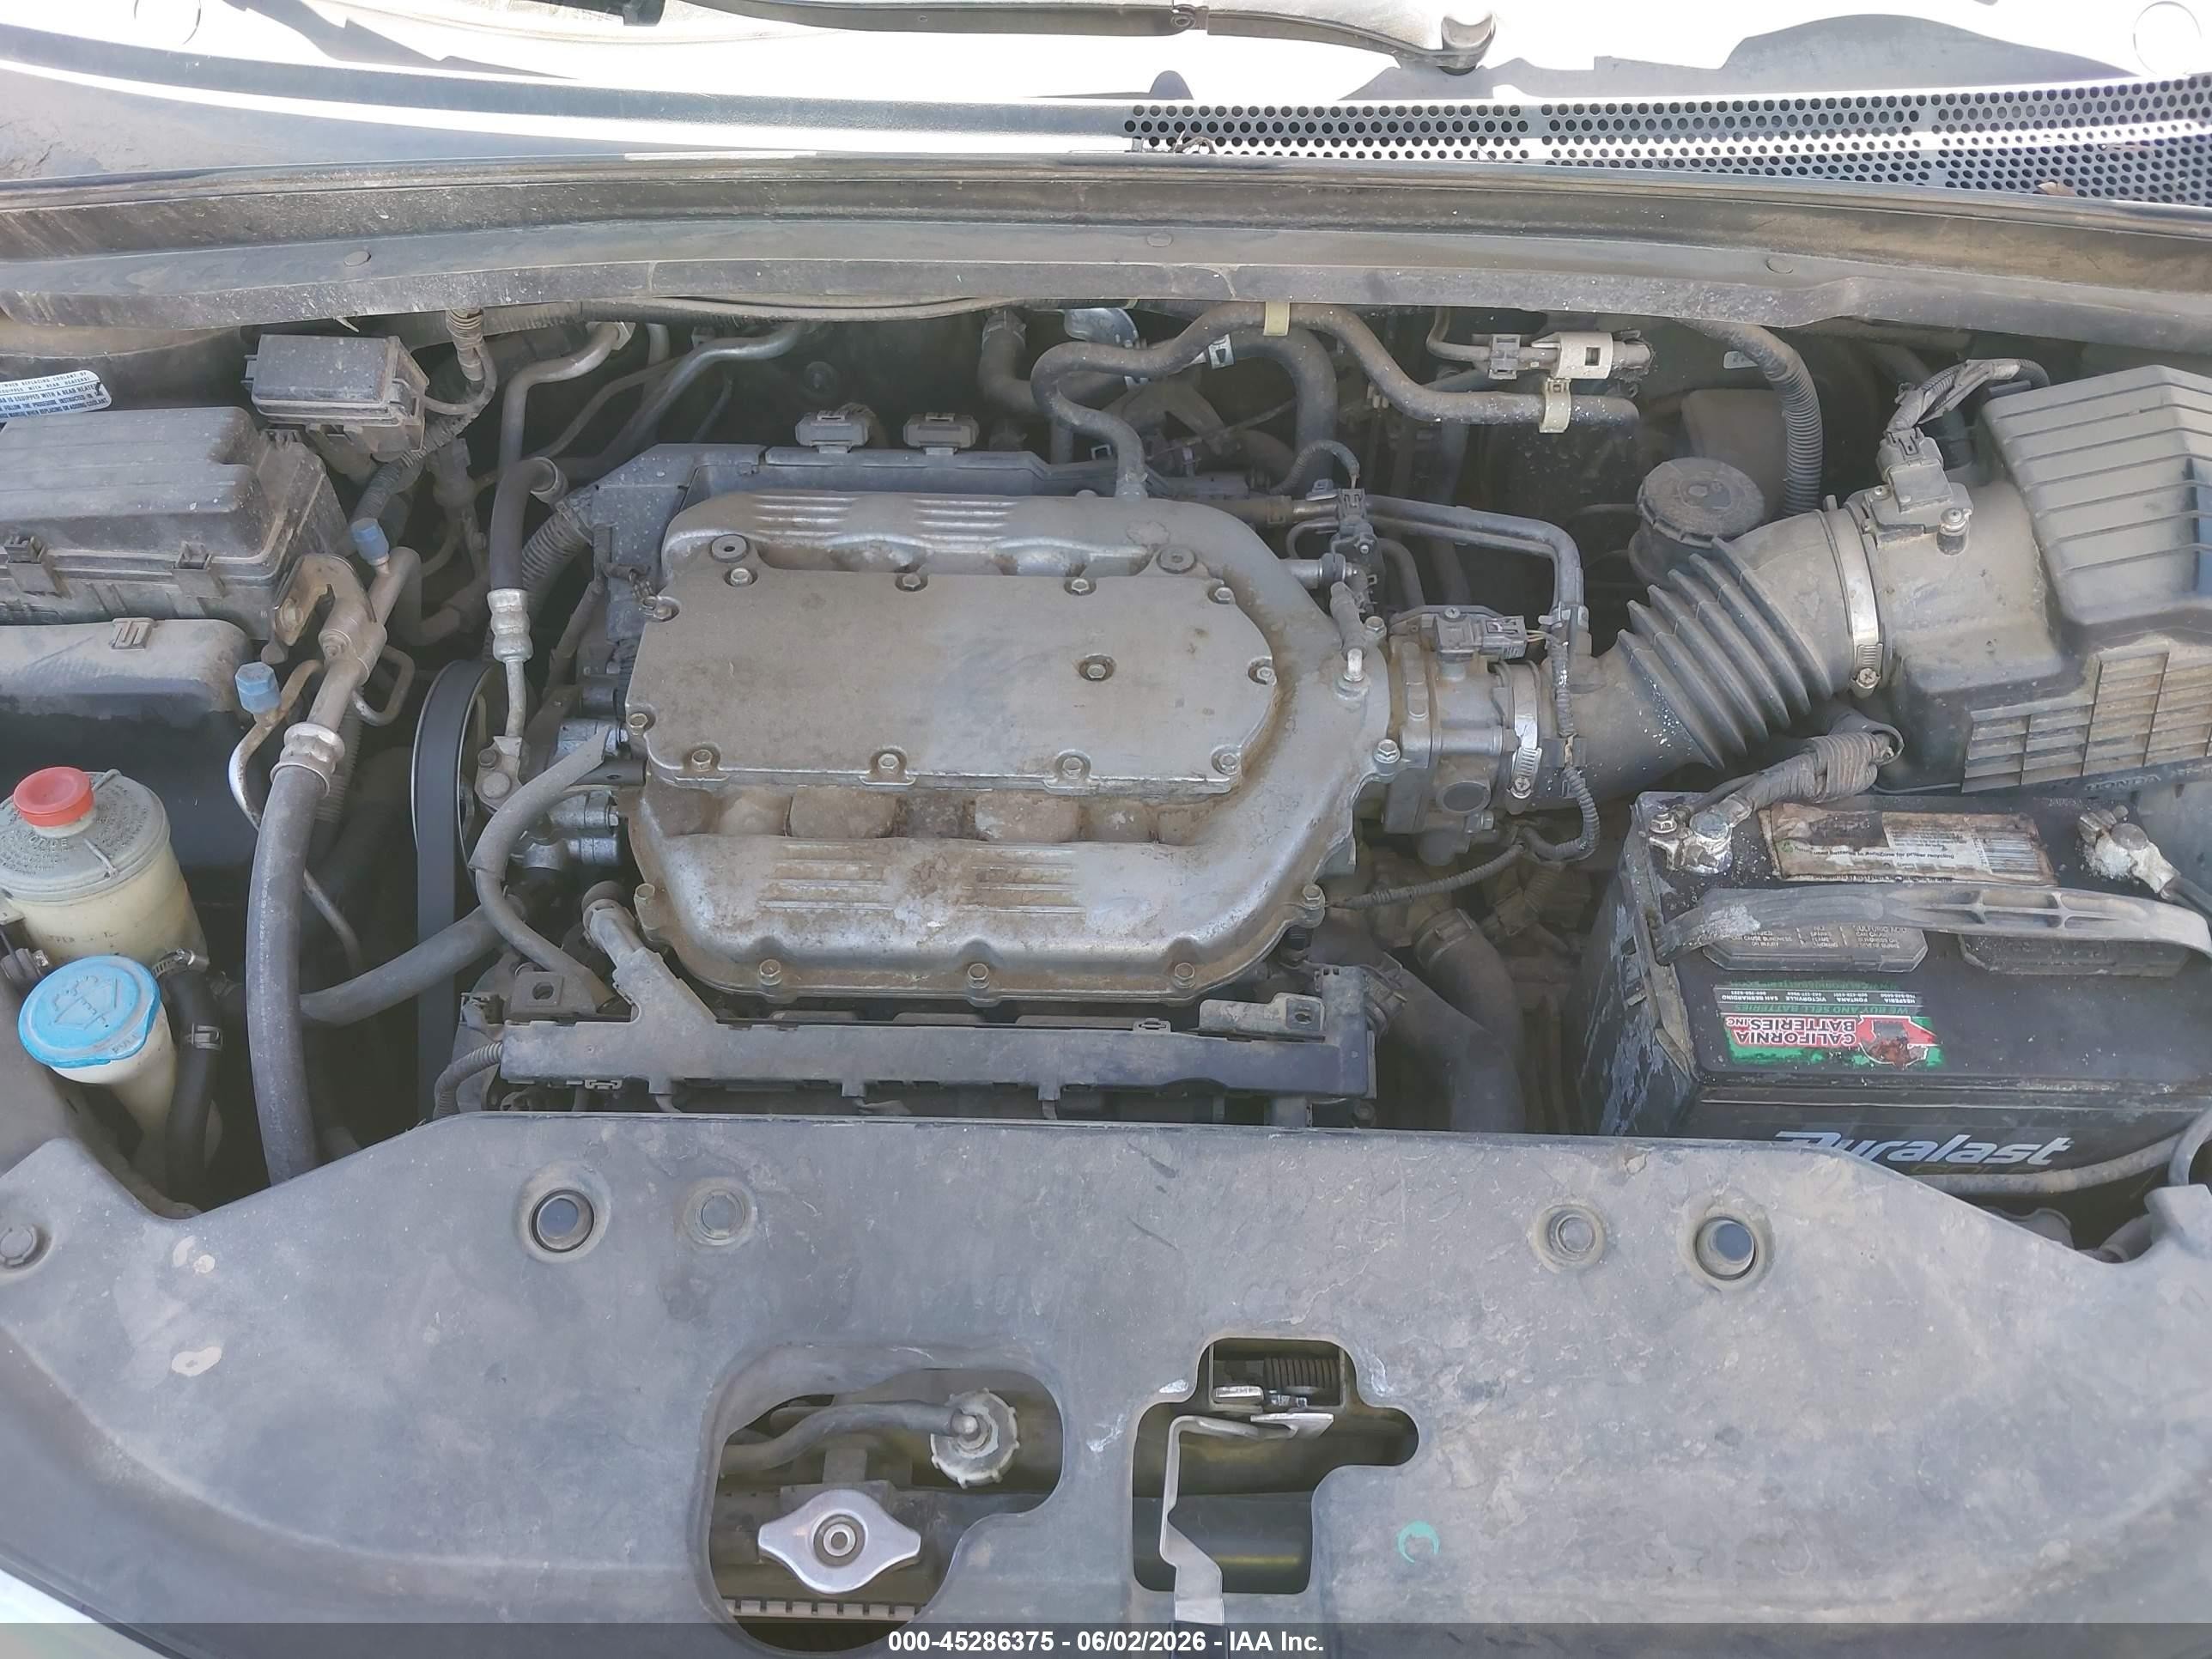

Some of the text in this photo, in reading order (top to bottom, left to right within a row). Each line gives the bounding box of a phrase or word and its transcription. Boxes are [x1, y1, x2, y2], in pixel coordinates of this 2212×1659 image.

[52, 373, 76, 382] COOLANT
[87, 397, 109, 407] COOLANT
[2085, 775, 2162, 791] HONDA
[1735, 1003, 1799, 1012] BATTERIES
[1803, 1005, 1831, 1013] SELL
[1735, 1030, 1856, 1045] CALIFORNIA
[1774, 1130, 2072, 1166] Duralast
